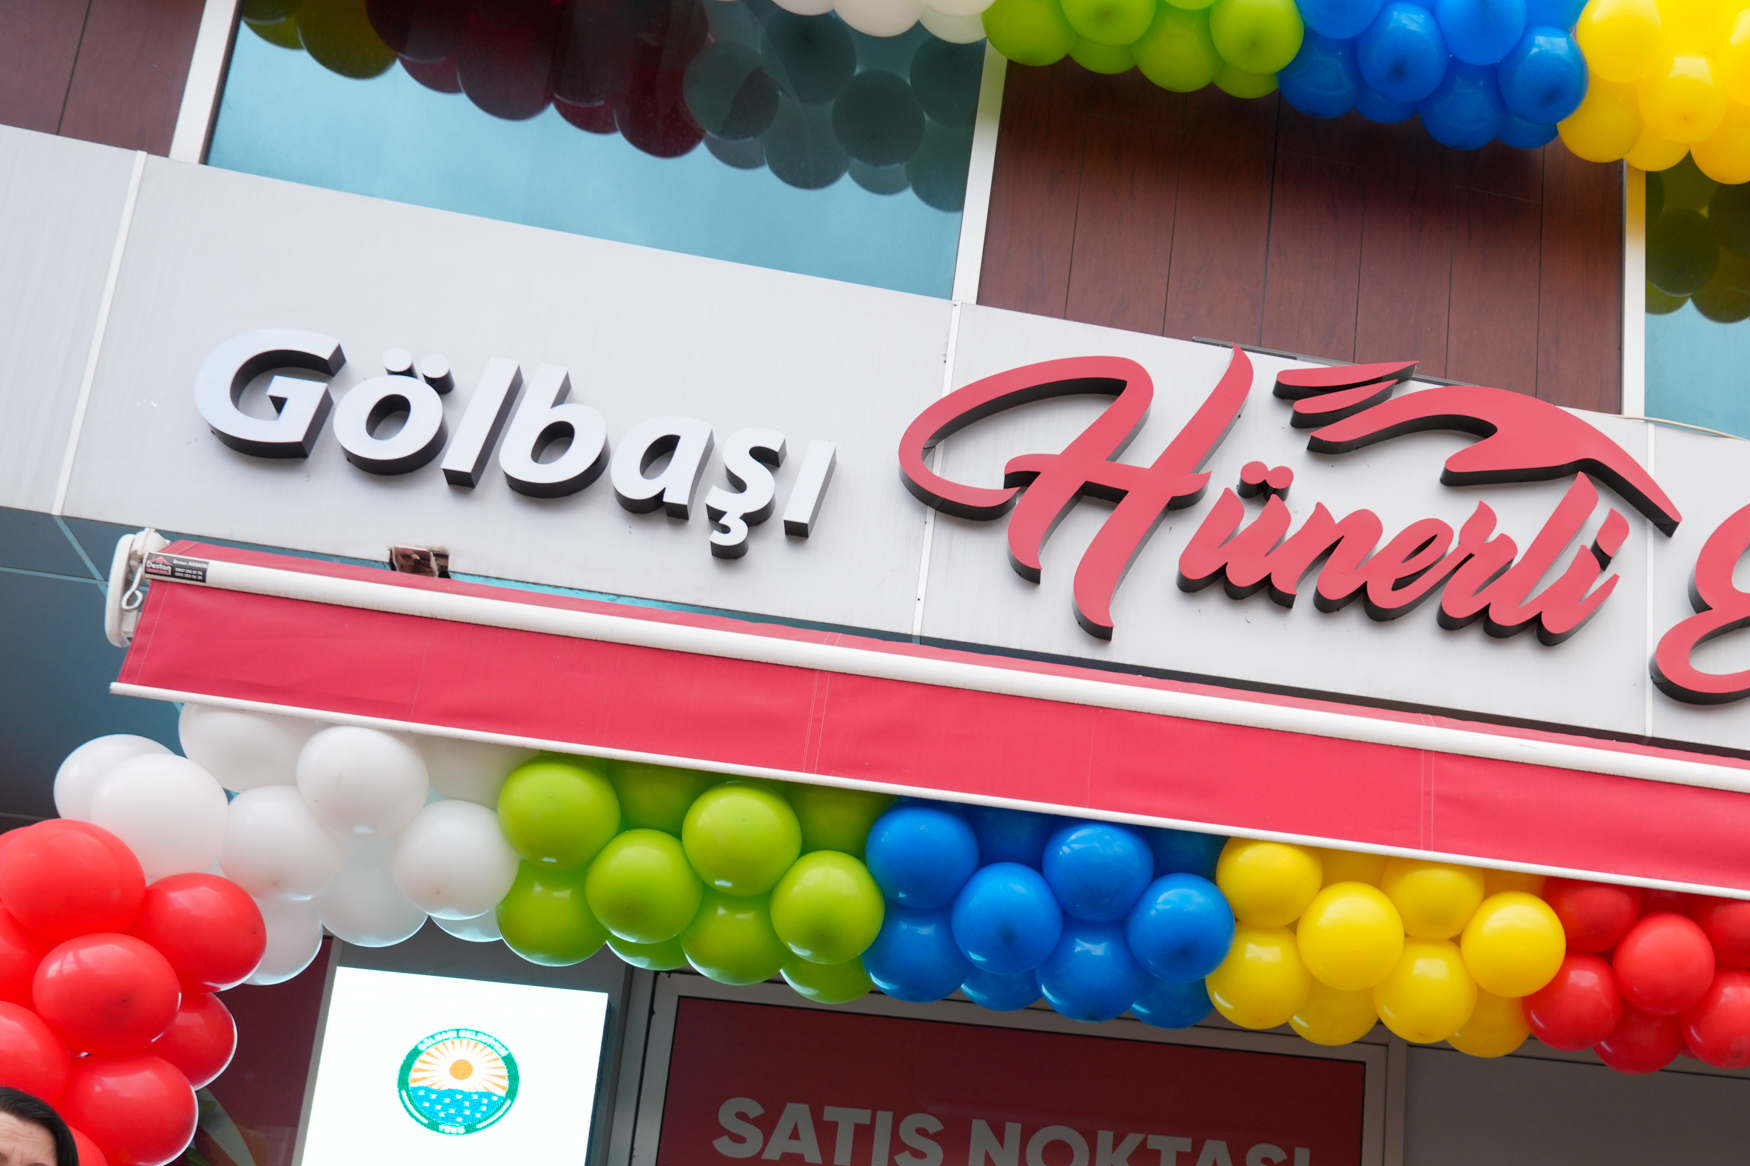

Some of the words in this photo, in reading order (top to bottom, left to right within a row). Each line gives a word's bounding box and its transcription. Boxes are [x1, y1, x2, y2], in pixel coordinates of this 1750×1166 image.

[146, 560, 172, 576] Destan
[195, 328, 837, 559] Gölbaşı
[898, 342, 1631, 646] Hünerli
